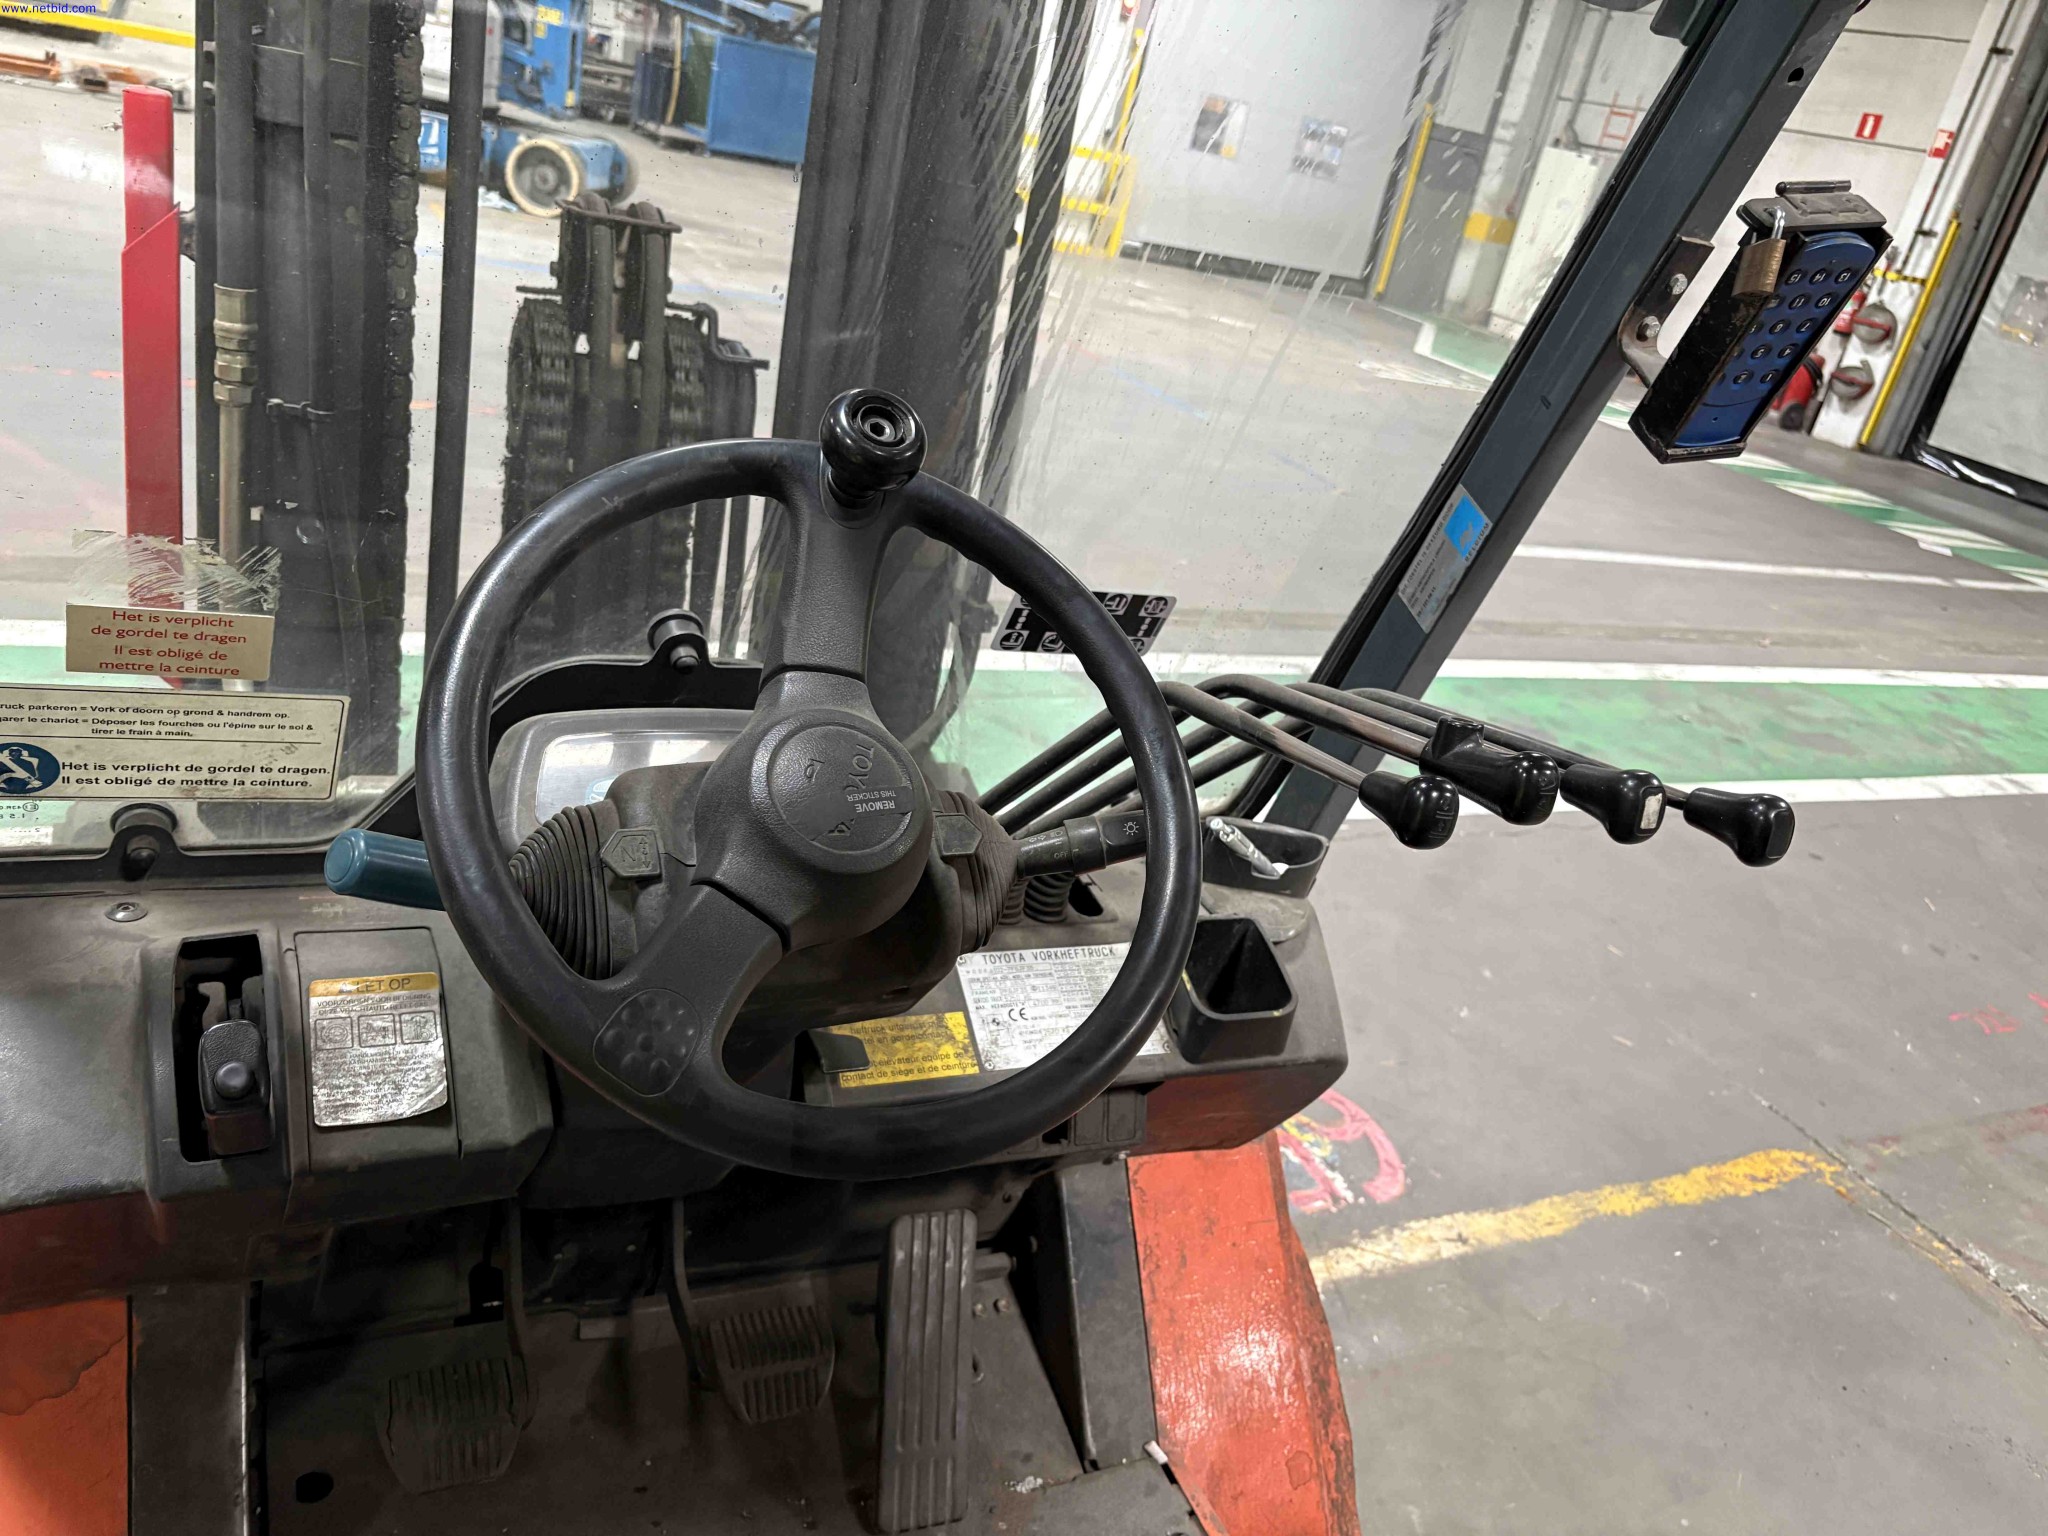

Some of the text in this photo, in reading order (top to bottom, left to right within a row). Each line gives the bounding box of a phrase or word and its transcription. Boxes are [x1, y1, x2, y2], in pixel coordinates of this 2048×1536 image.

[1789, 273, 1801, 283] 15
[1813, 273, 1825, 283] 14
[1838, 273, 1850, 282] 13
[1792, 298, 1804, 307] 11
[1818, 297, 1831, 307] 10
[1464, 522, 1490, 562] BELGIUM
[112, 610, 235, 628] Het is verplicht
[91, 625, 247, 645] de gordel te dragen
[128, 647, 152, 657] est
[156, 647, 204, 662] obligé
[208, 651, 228, 661] de
[99, 661, 240, 676] mettre la ceinture
[0, 703, 25, 711] ruck
[28, 704, 77, 713] parkeren
[90, 705, 116, 713] Vork
[132, 707, 164, 715] doorn
[166, 709, 180, 717] op
[183, 709, 214, 717] grond
[40, 716, 79, 724] chariot
[91, 717, 138, 727] Déposer
[158, 719, 205, 727] fourches
[223, 722, 256, 730] l'épine
[61, 762, 331, 776] Het is verplicht de gordel te dragen.
[75, 777, 100, 785] est
[104, 776, 153, 787] obligé
[157, 777, 176, 786] de
[180, 778, 229, 786] mettre
[233, 778, 245, 786] la
[250, 778, 313, 787] ceinture.
[846, 790, 897, 802] THIS STICKER
[854, 800, 896, 813] REMOVE
[981, 946, 1116, 965] TOYOTA VORKHEFTRUCK
[356, 977, 411, 993] LET OP
[1008, 1007, 1029, 1022] CE
[878, 1036, 889, 1044] en
[953, 1050, 964, 1059] de
[841, 1069, 875, 1083] contact
[877, 1069, 888, 1078] de
[917, 1065, 926, 1074] et
[928, 1063, 939, 1072] de
